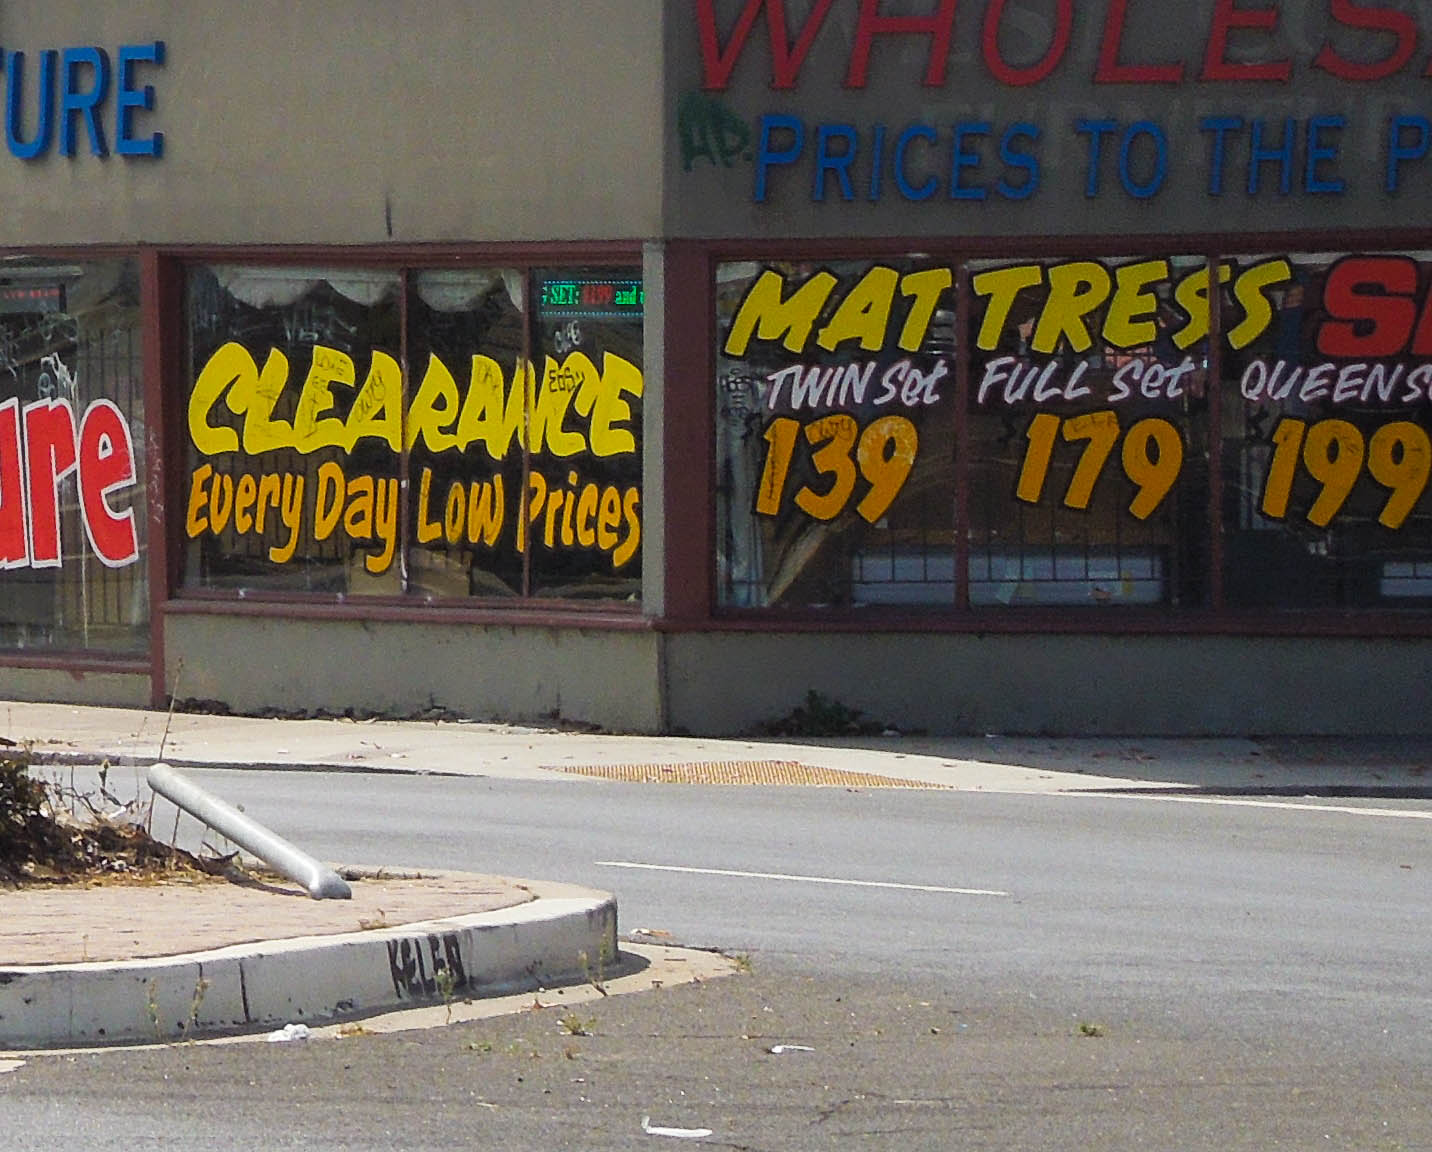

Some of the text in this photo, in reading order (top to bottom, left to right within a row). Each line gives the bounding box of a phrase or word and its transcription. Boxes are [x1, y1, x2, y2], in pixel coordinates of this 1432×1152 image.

[753, 113, 1040, 203] PRICES
[1077, 118, 1167, 200] TO
[1200, 116, 1347, 198] THE
[615, 285, 637, 305] and
[723, 257, 1432, 358] MATTRESS S
[187, 341, 644, 460] CLEARANCE
[766, 359, 876, 410] TWIN
[874, 357, 948, 407] Set
[977, 356, 1196, 404] FULL Set
[1239, 359, 1405, 403] QUEEN
[755, 414, 920, 525] 139
[1015, 410, 1184, 521] 179
[1261, 417, 1432, 530] 199
[185, 461, 641, 574] Every Day Low Prices
